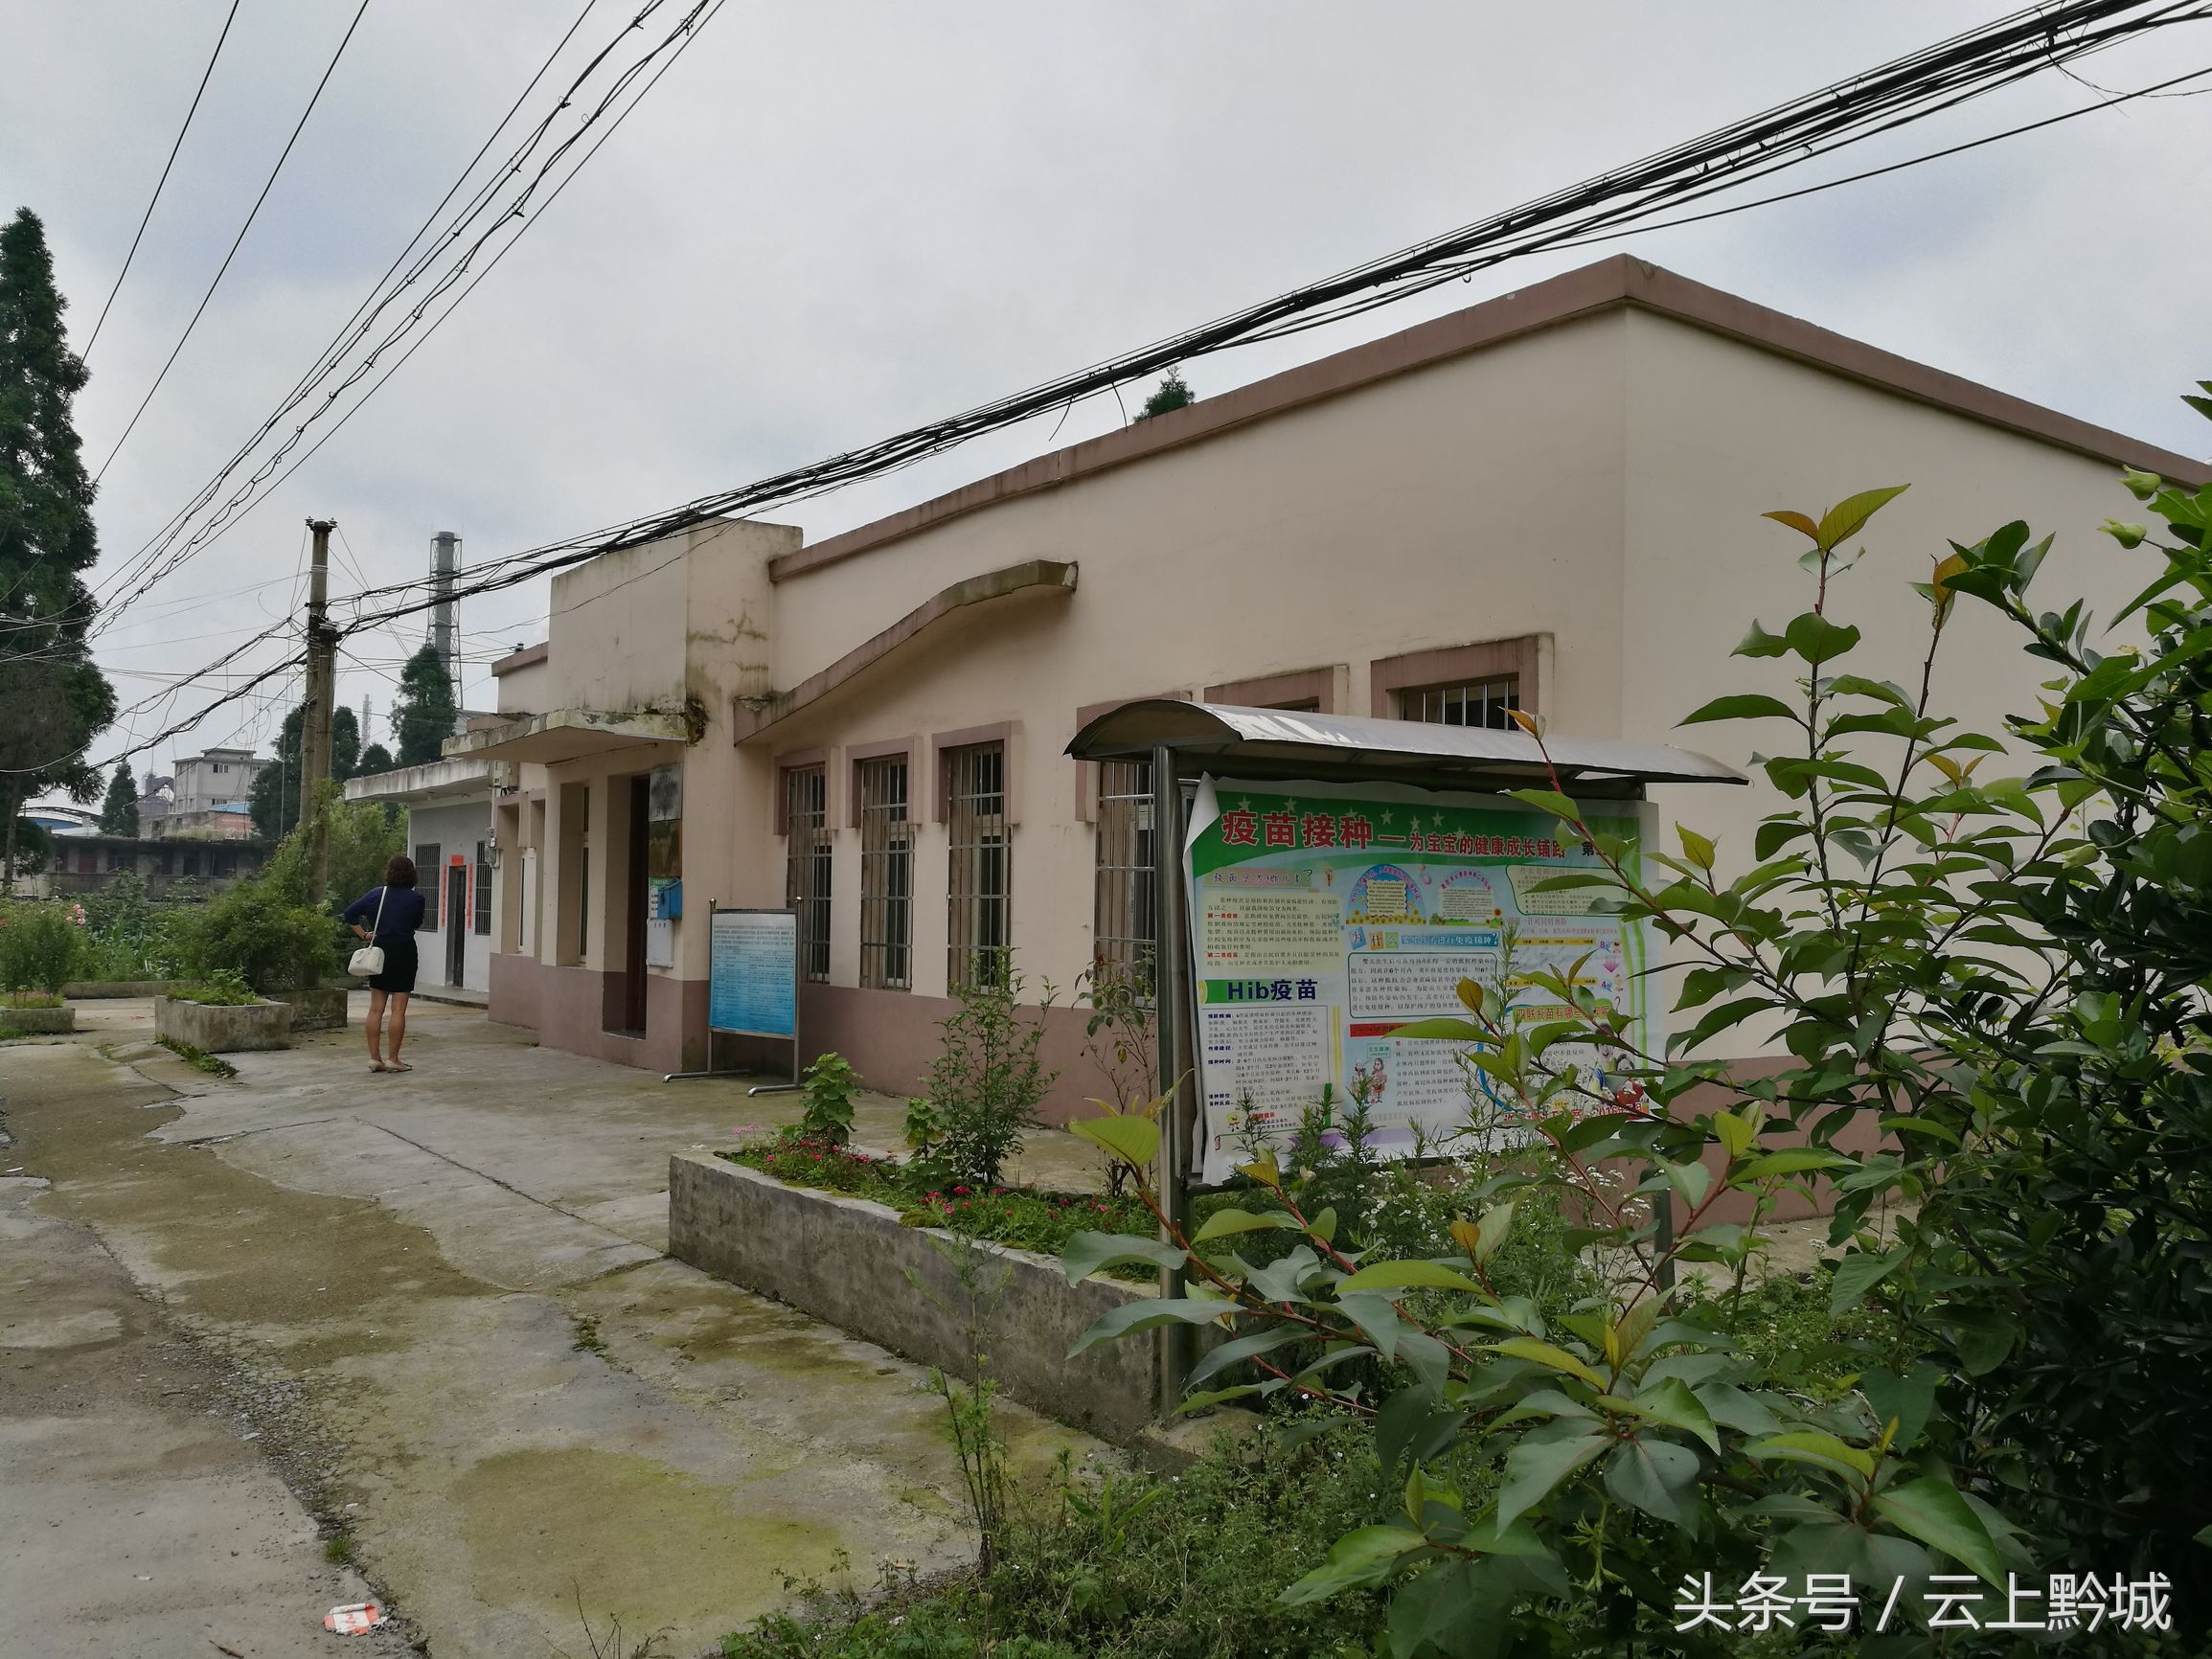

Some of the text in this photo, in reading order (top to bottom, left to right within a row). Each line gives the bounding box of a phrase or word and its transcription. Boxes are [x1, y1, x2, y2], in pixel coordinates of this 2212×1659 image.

[1221, 808, 1374, 849] 疫苗接种
[1227, 978, 1318, 1001] Hib疫苗
